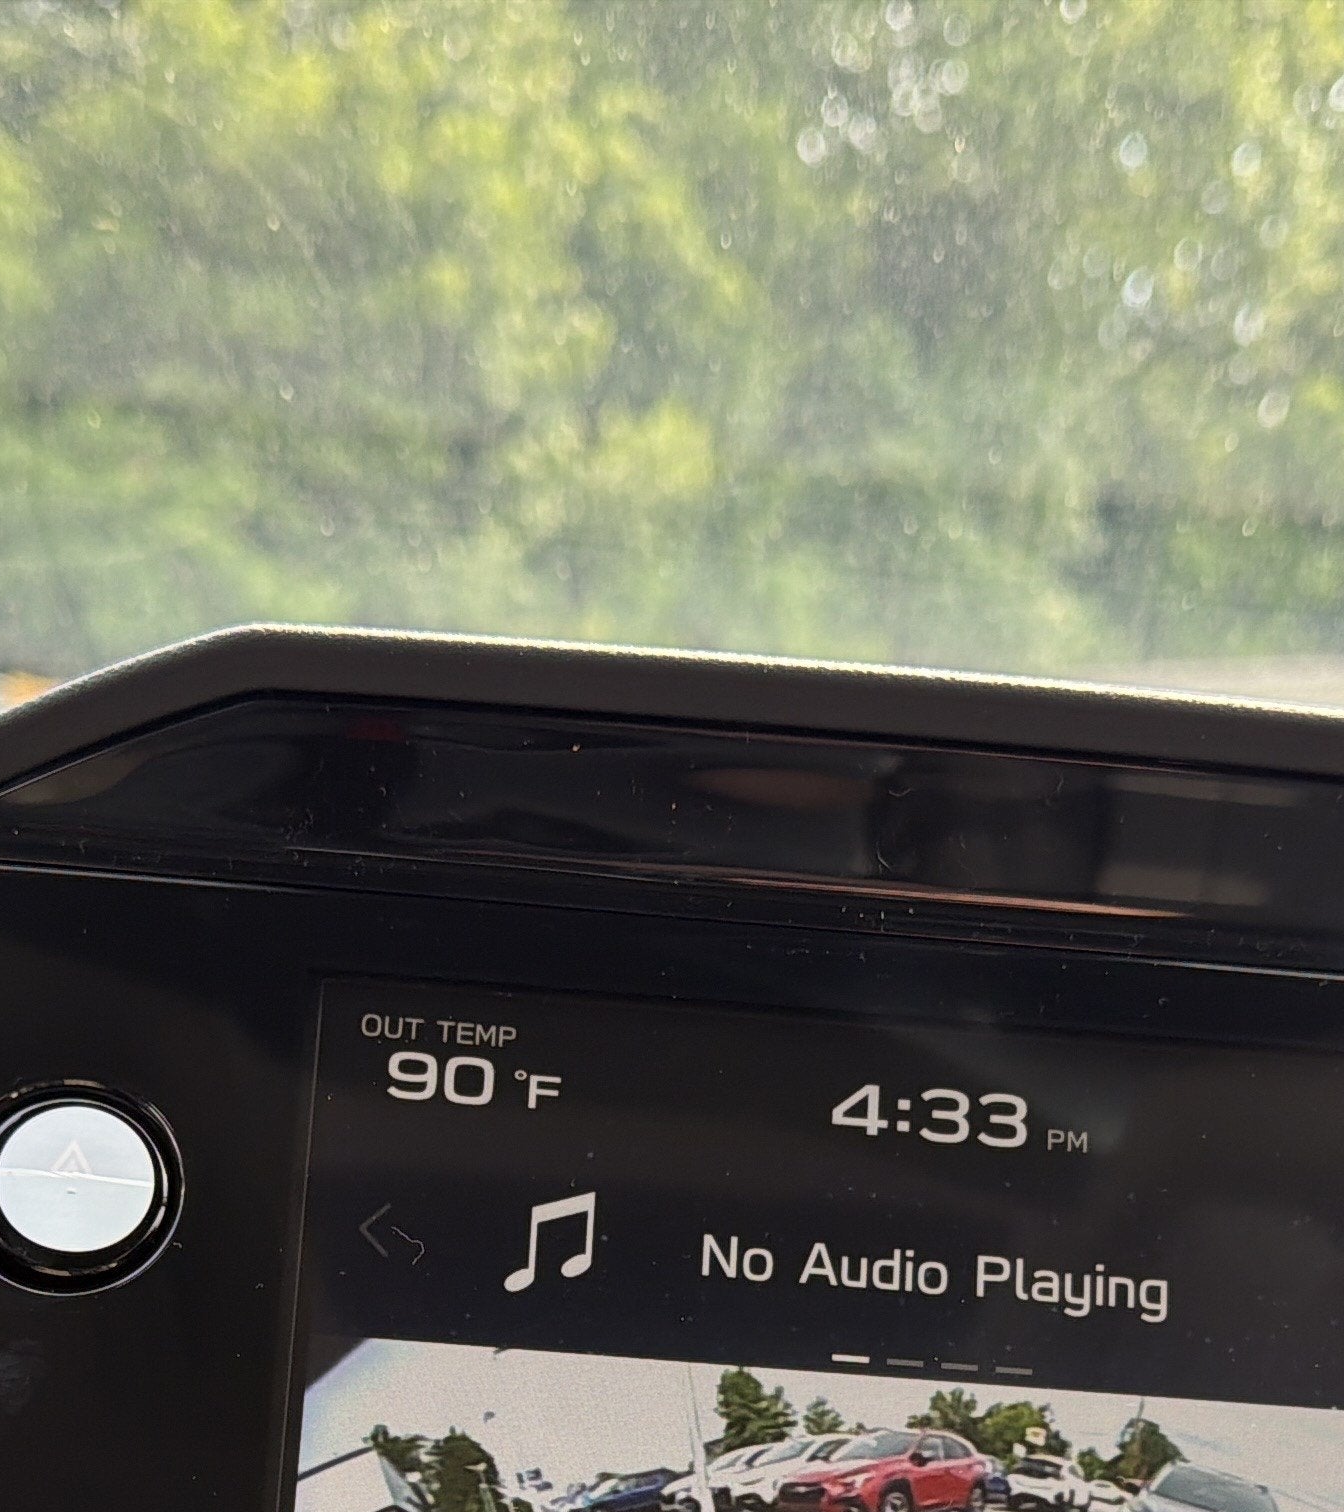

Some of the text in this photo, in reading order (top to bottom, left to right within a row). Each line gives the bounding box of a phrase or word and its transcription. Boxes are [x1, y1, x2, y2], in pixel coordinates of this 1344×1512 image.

[360, 1013, 518, 1048] OUT TEMP
[386, 1052, 496, 1106] 90
[831, 1083, 1089, 1154] 4:33 PM
[699, 1234, 1170, 1324] No Audio Playing
